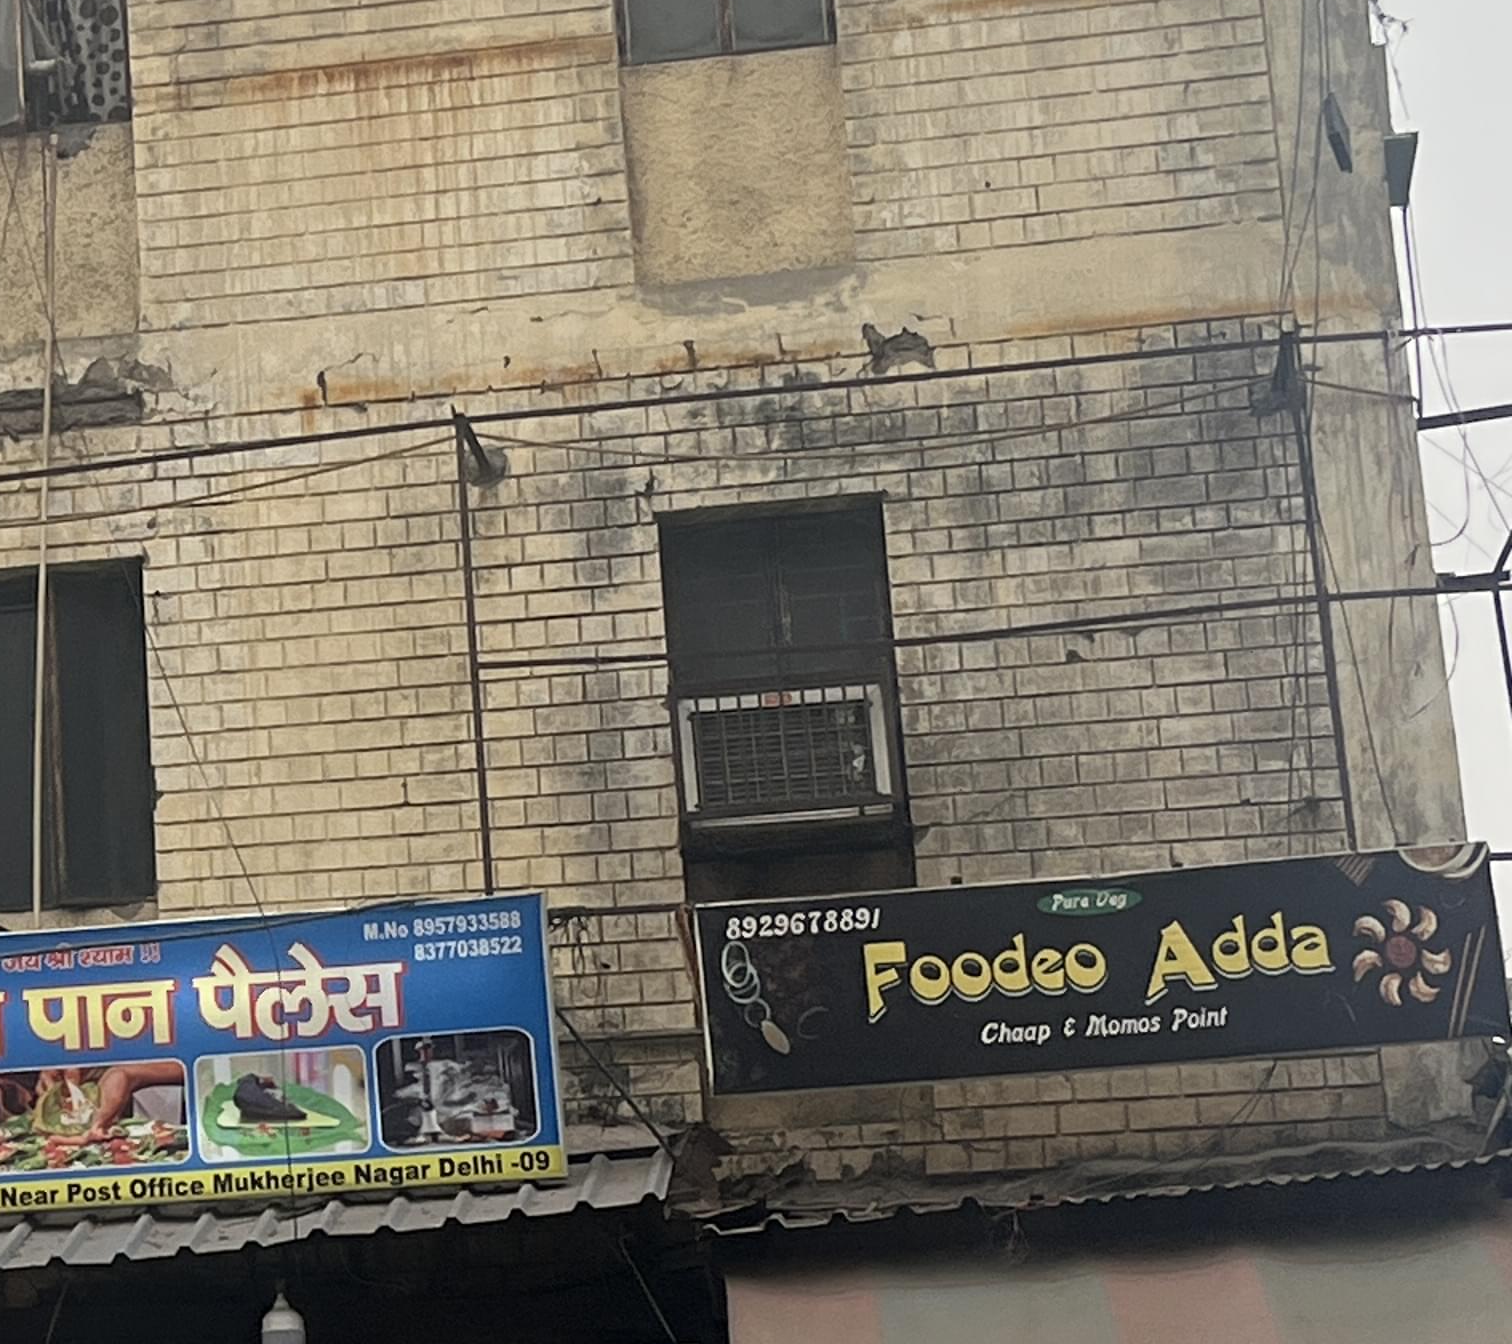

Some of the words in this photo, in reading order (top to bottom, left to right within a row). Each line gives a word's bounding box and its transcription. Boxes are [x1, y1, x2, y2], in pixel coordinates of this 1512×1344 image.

[364, 922, 409, 943] M.No
[412, 910, 521, 940] 8957933588
[726, 906, 880, 940] 8929678891
[414, 935, 523, 961] 8377038522
[862, 933, 1107, 1024] Foodeo
[1144, 912, 1335, 1006] Adda
[24, 976, 176, 1047] पान
[191, 941, 407, 1042] पैलेस
[980, 1019, 1050, 1047] Chaap
[1085, 1009, 1161, 1038] Momos
[1172, 1005, 1228, 1032] Point
[0, 1185, 61, 1209] Near
[70, 1179, 123, 1204] Post
[129, 1174, 204, 1200] Office
[211, 1162, 346, 1197] Mukherjee
[354, 1157, 433, 1189] Nagar
[439, 1152, 504, 1177] Delhi
